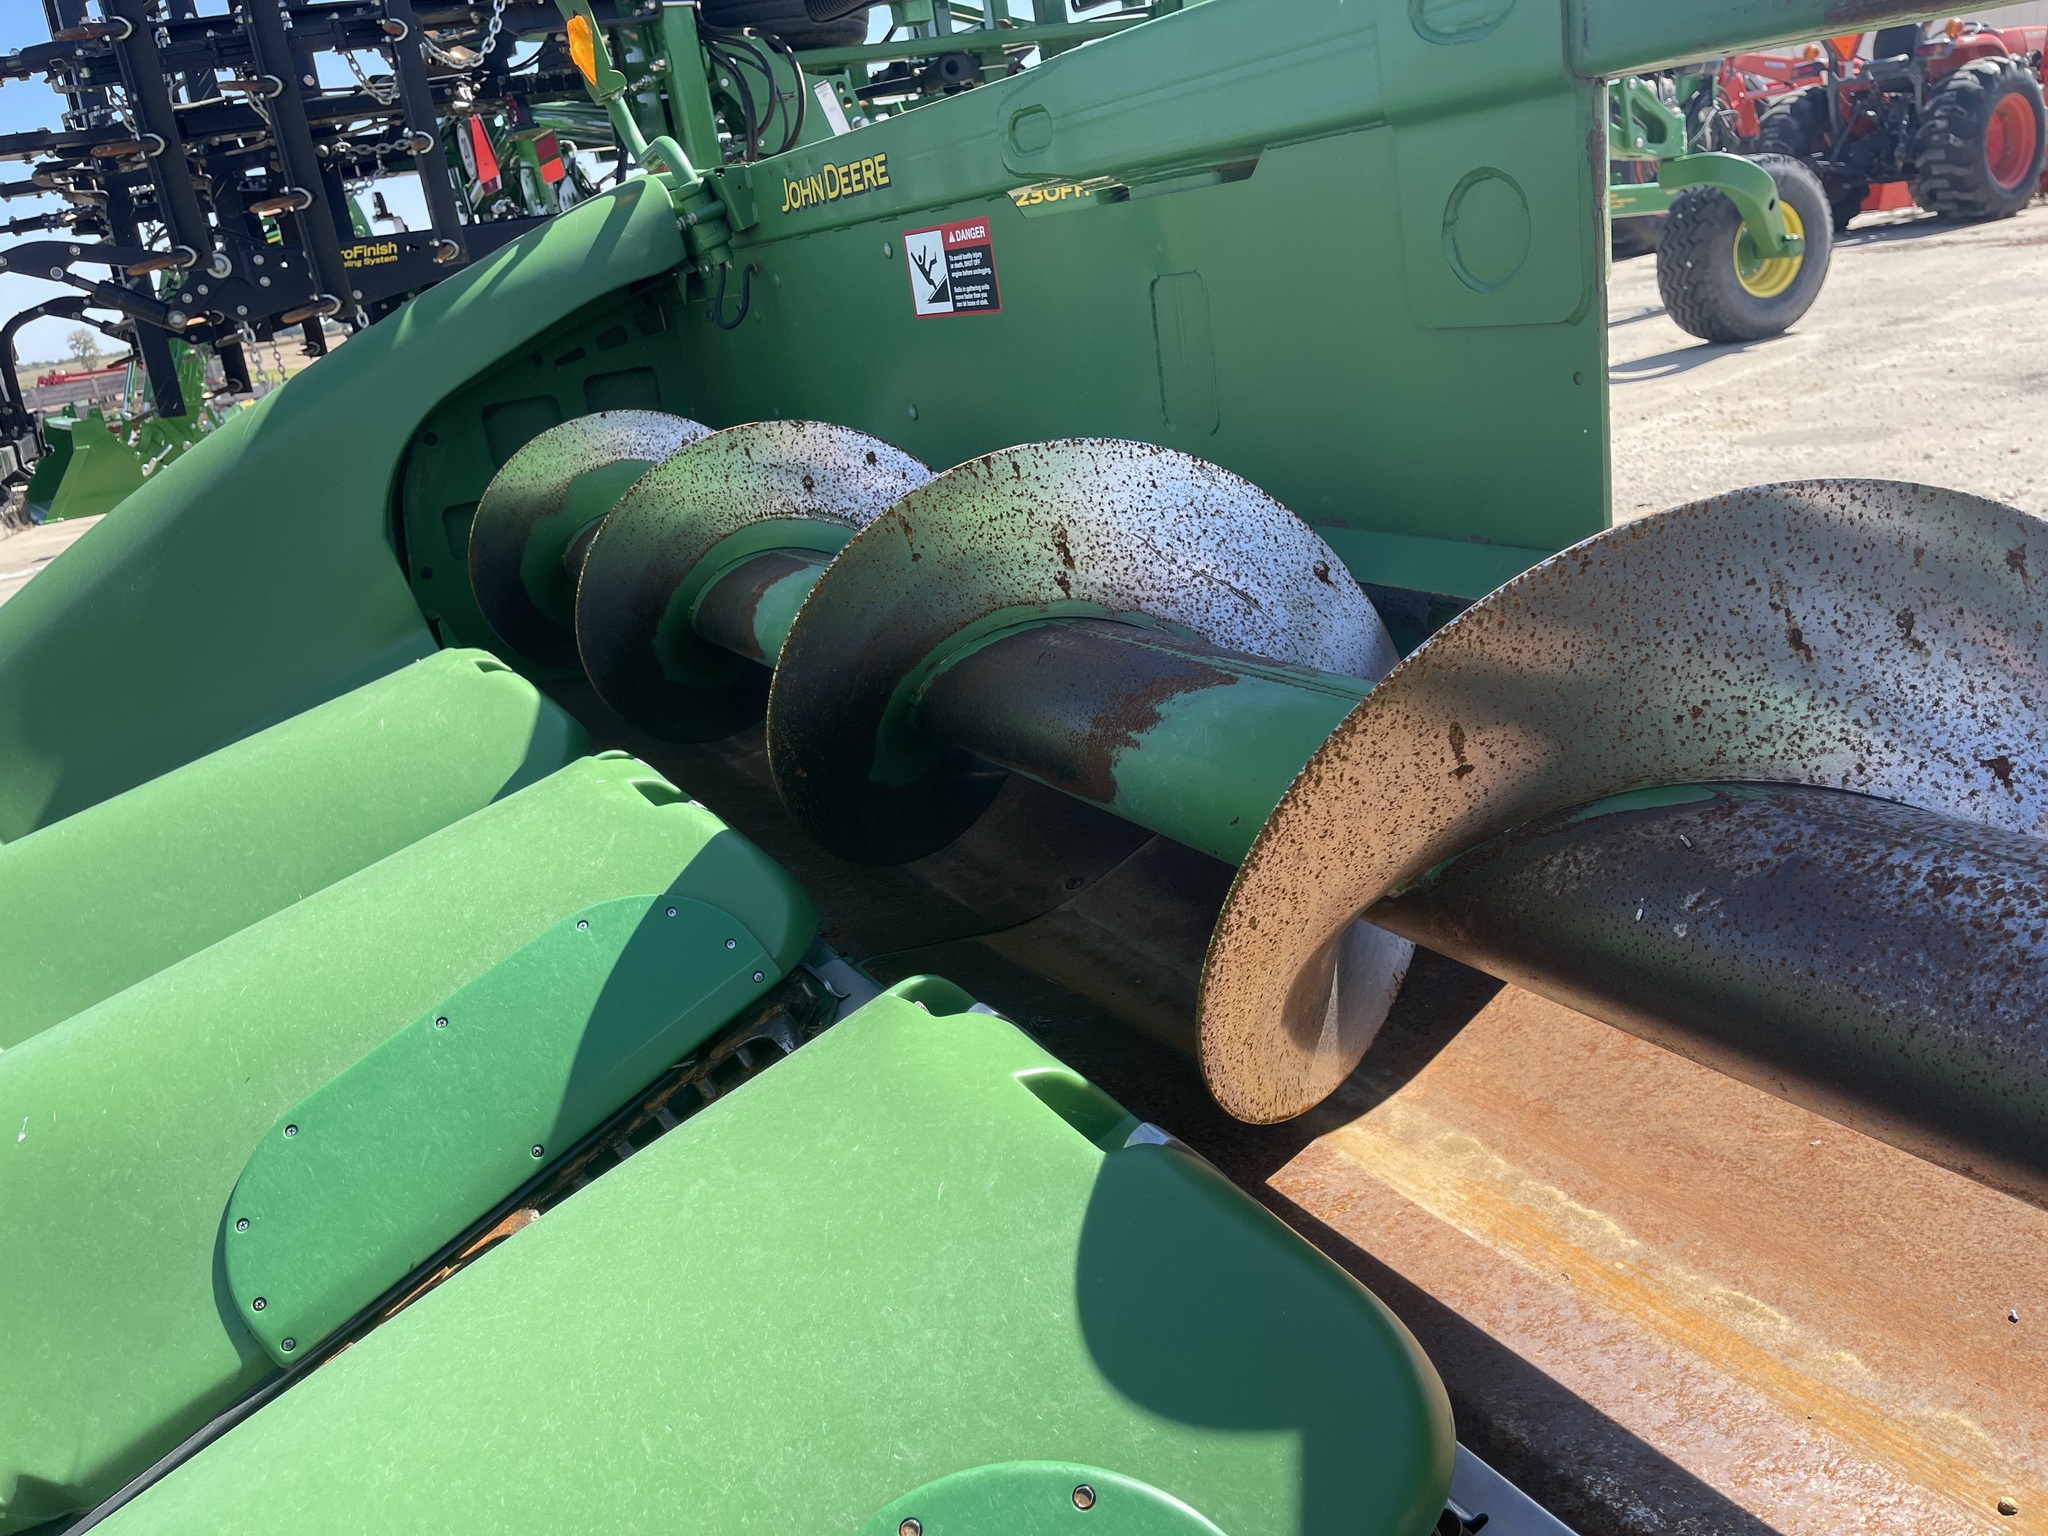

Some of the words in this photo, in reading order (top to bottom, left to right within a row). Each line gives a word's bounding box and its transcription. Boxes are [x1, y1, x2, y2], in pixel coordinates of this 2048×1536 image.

[781, 173, 826, 214] JOHN
[823, 152, 891, 202] DEERE
[955, 225, 986, 242] DANGER
[363, 255, 398, 266] System
